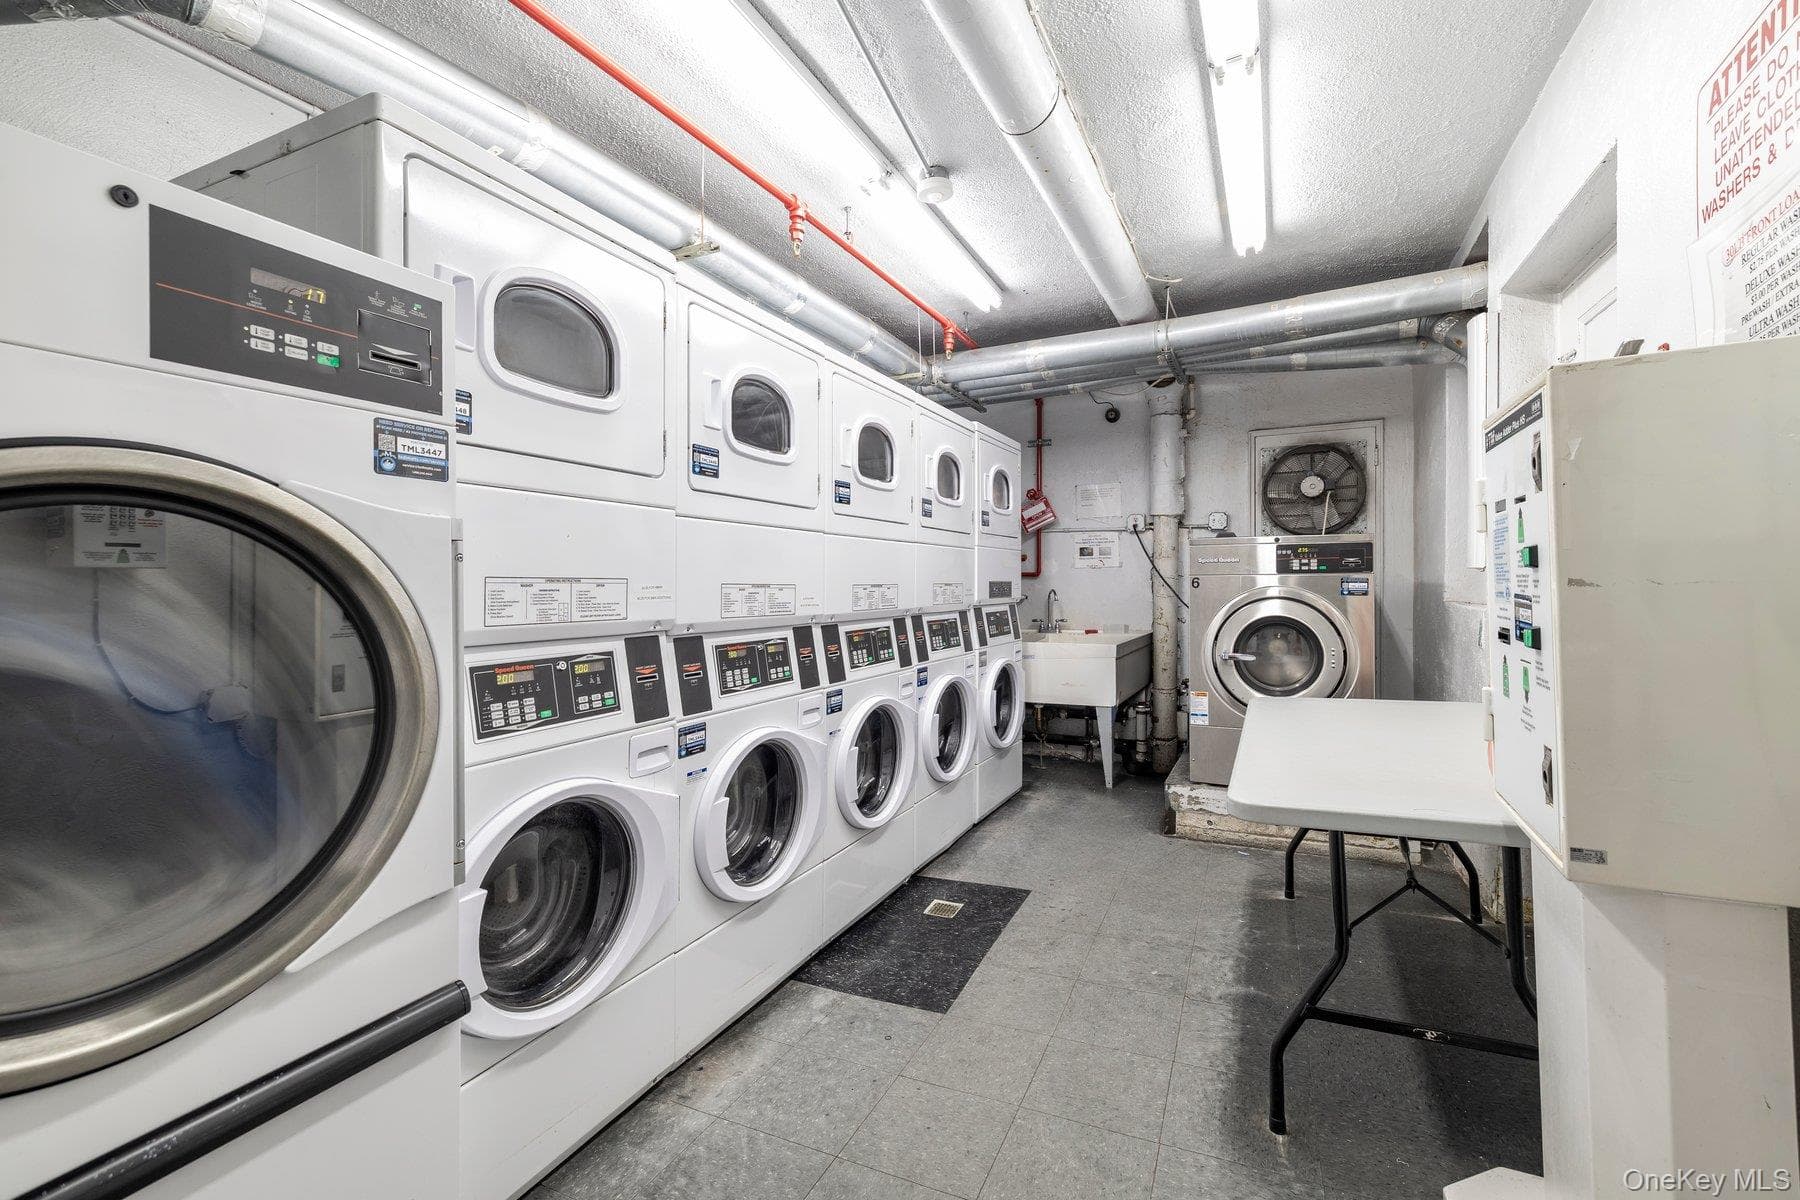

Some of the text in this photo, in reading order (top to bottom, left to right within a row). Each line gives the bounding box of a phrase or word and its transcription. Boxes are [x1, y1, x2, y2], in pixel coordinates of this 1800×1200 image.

[1714, 45, 1788, 141] PLEASE DO
[1715, 112, 1750, 164] LEAVE
[1702, 157, 1760, 224] WASHERS
[1768, 142, 1777, 165] &
[1746, 207, 1777, 243] FRONT
[1741, 227, 1778, 265] REGULAR
[1745, 263, 1776, 295] DELUXE
[1767, 278, 1779, 293] PER
[307, 288, 324, 304] 17
[1741, 298, 1770, 326] PREWASH
[1749, 294, 1800, 337] ULTRA WASH
[401, 444, 442, 457] TML3447
[1191, 577, 1200, 588] 6
[495, 665, 514, 674] Speed
